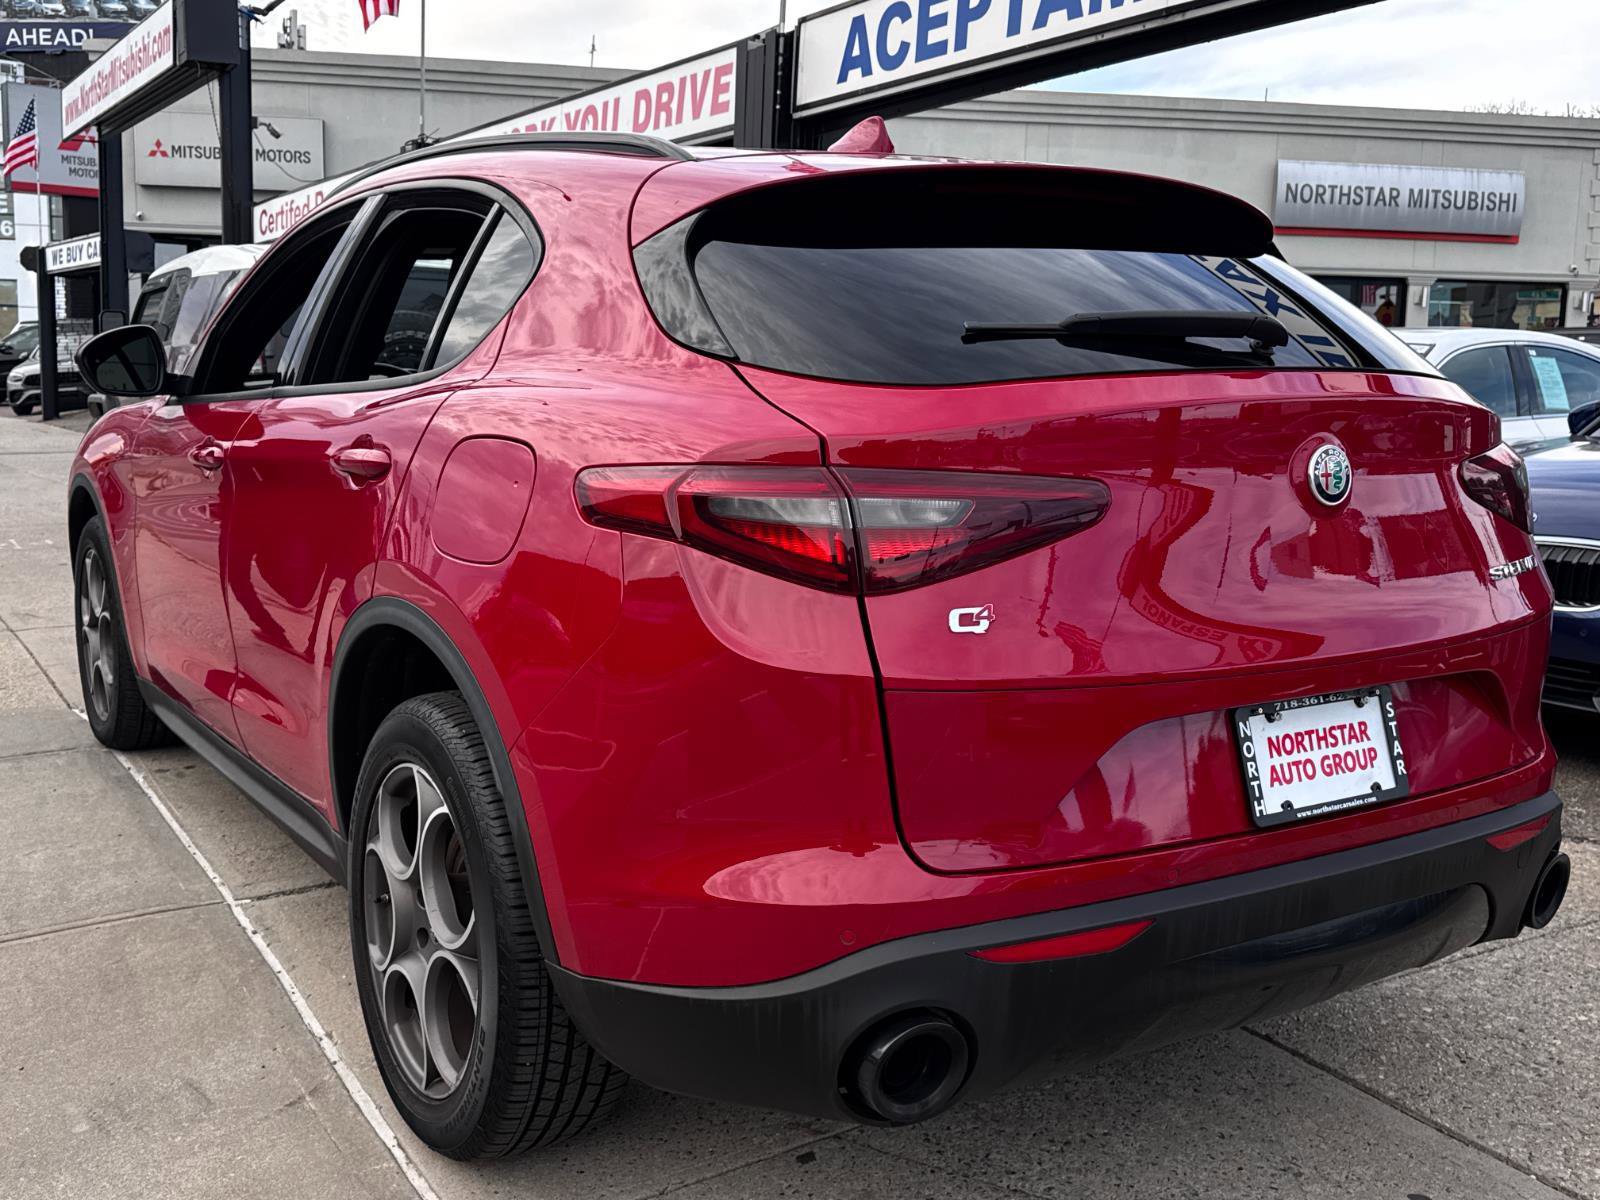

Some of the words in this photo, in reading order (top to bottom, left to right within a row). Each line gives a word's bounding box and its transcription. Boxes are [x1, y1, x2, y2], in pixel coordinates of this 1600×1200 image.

[633, 62, 734, 133] DRIVE
[61, 155, 97, 168] MITSUB
[171, 145, 221, 160] MITSUB
[256, 149, 311, 164] MOTORS
[1285, 183, 1401, 208] NORTHSTAR
[1408, 187, 1517, 213] MITSUBISHI
[52, 248, 64, 266] WE
[66, 244, 84, 263] BUY
[1274, 692, 1354, 711] 718-361-62
[1267, 720, 1372, 759] NORTHSTAR
[1385, 702, 1407, 775] STAR
[1239, 721, 1268, 817] NORTH
[1269, 758, 1317, 788] AUTO
[1320, 747, 1378, 777] GROUP
